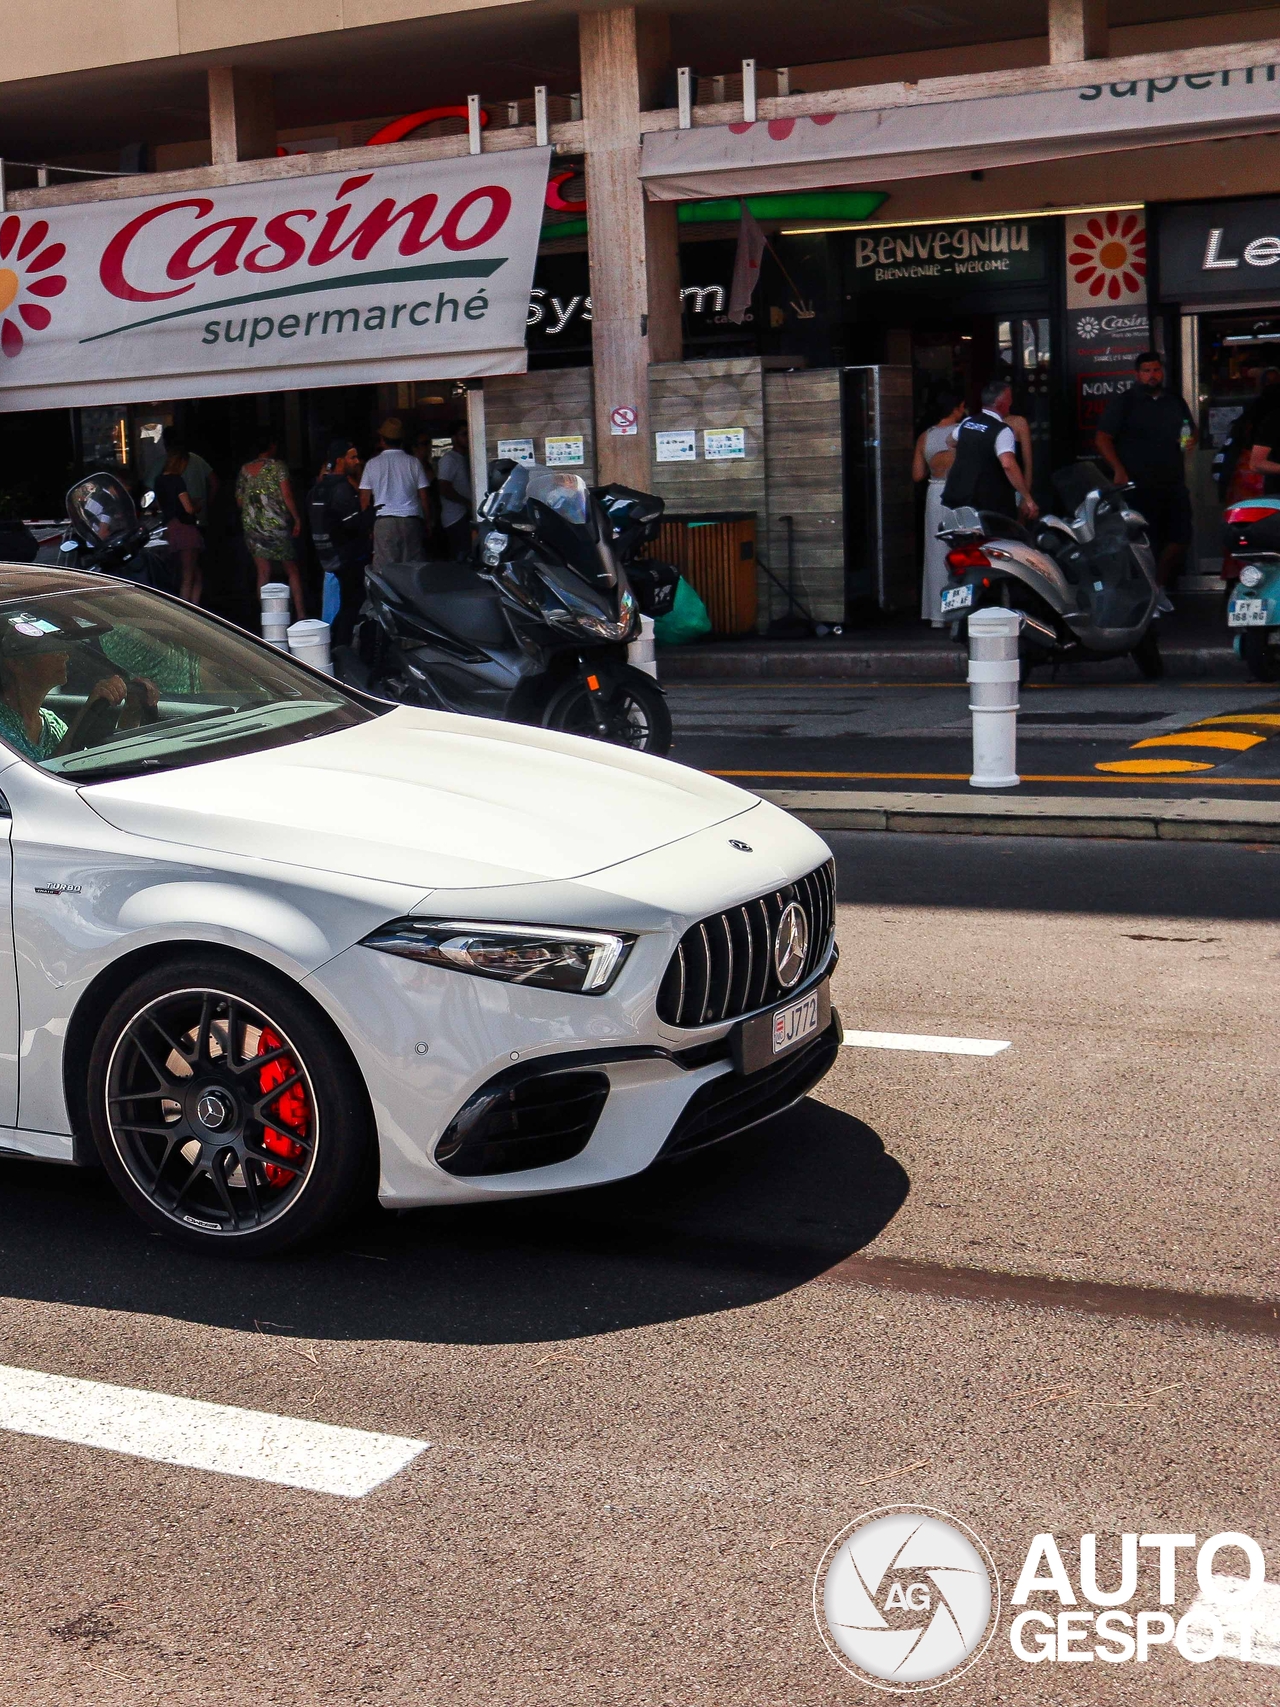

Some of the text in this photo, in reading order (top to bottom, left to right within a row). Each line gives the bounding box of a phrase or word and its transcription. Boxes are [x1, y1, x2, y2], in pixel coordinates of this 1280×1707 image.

[99, 173, 512, 302] Casino
[202, 288, 489, 348] supermarché
[1101, 314, 1150, 331] Casin
[1082, 381, 1114, 396] NON
[45, 881, 83, 891] TURBO
[786, 997, 816, 1040] J772
